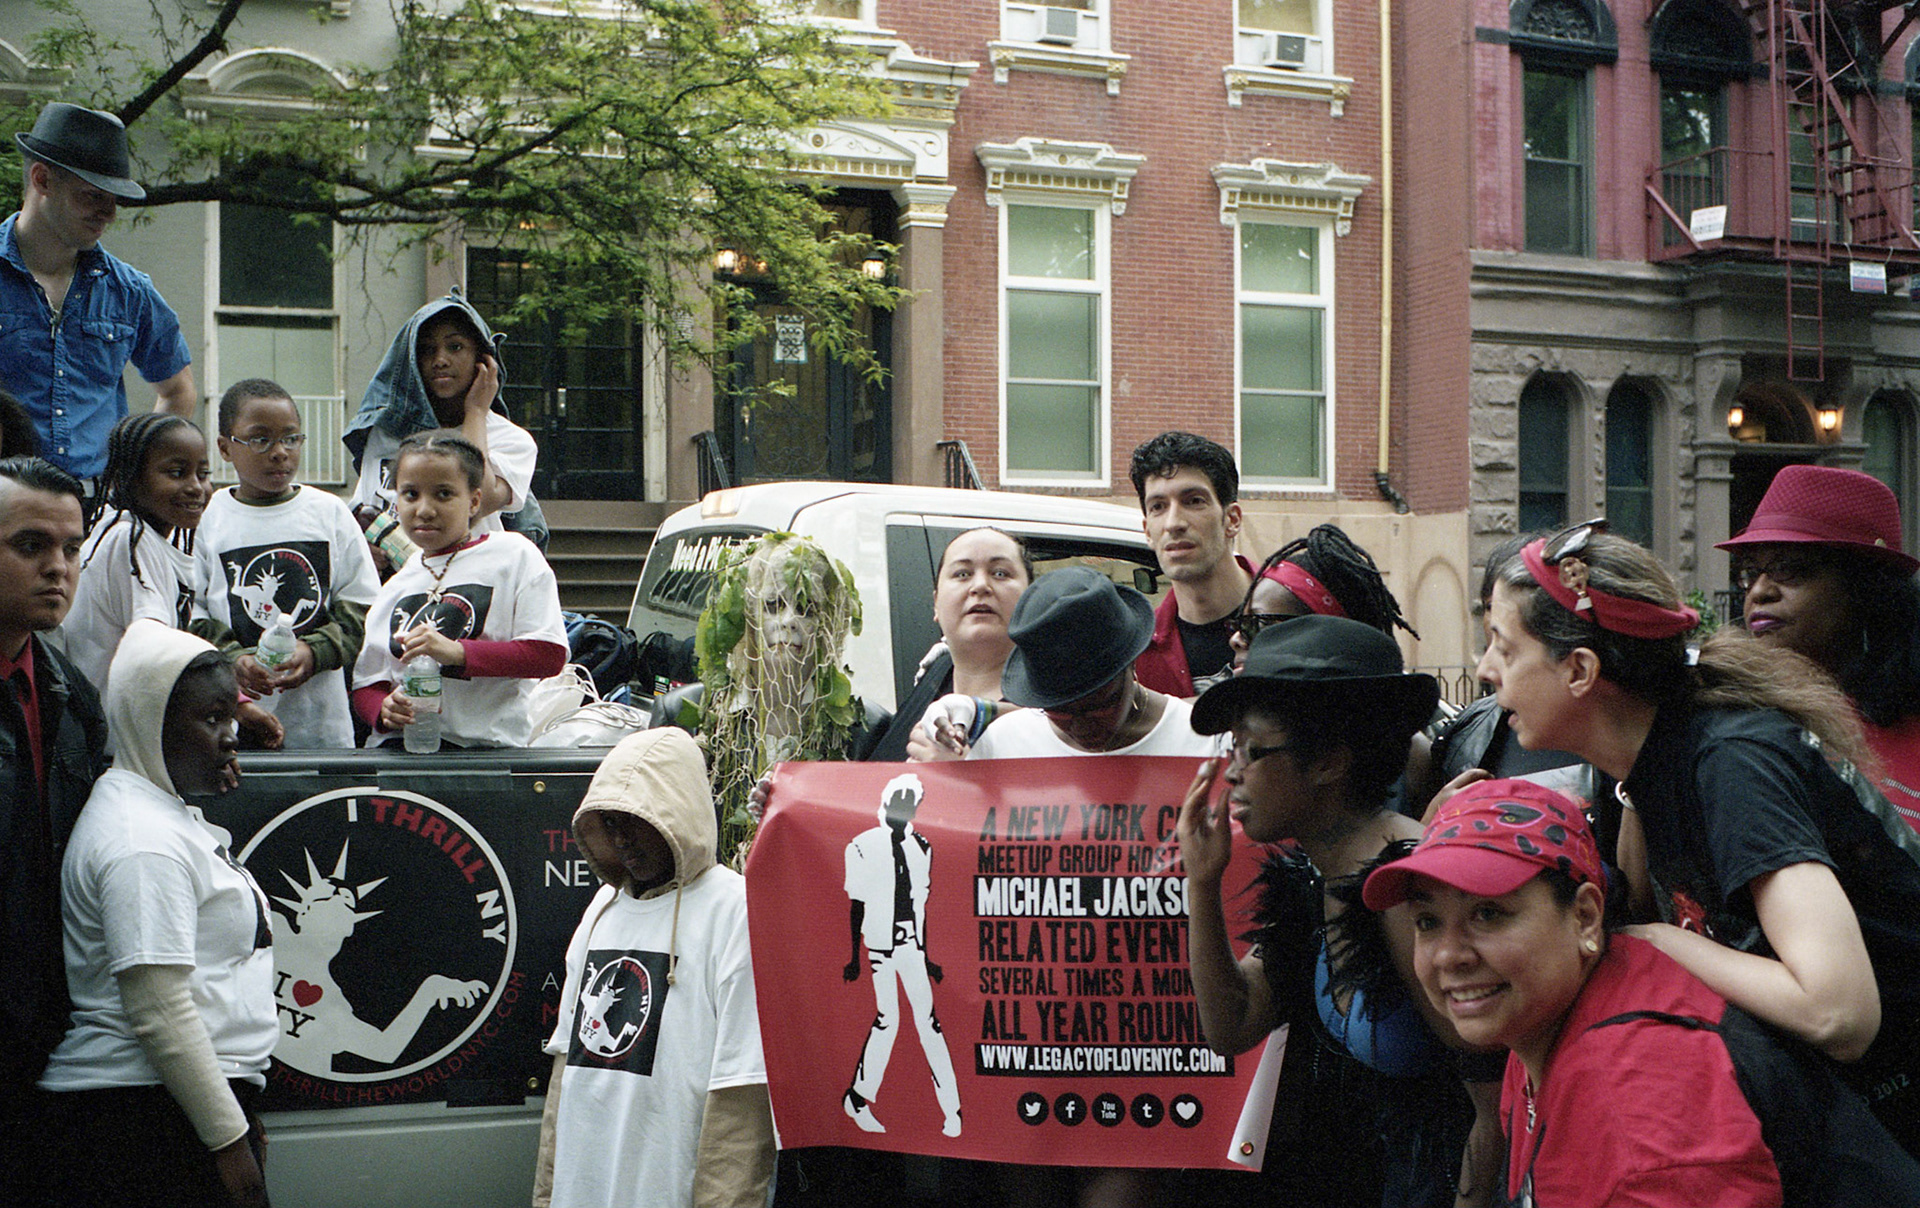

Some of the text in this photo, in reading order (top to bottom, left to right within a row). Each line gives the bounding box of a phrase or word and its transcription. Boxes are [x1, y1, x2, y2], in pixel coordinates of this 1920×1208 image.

[670, 537, 703, 572] Need
[696, 545, 708, 572] a
[254, 610, 272, 621] NY
[979, 806, 997, 841] A
[1006, 805, 1069, 842] NEW
[1080, 804, 1148, 841] YORK
[347, 798, 507, 945] I THRILL NY
[545, 860, 603, 887] NE
[978, 845, 1185, 873] MEETUP GROUP HOST
[978, 877, 1087, 916] MICHAEL
[979, 921, 1096, 963] RELATED
[274, 970, 292, 998] I
[541, 971, 559, 991] A
[979, 967, 1058, 995] SEVERAL
[1064, 968, 1124, 996] TIMES
[1132, 968, 1145, 996] A
[276, 1003, 316, 1038] Y
[581, 1025, 598, 1040] NY
[981, 999, 1028, 1041] ALL
[1036, 1001, 1109, 1042] YEAR
[980, 1044, 1226, 1073] WWW.LEGACYOFLOVENYC.COM
[1101, 1110, 1117, 1119] Tube
[1102, 1101, 1116, 1110] You
